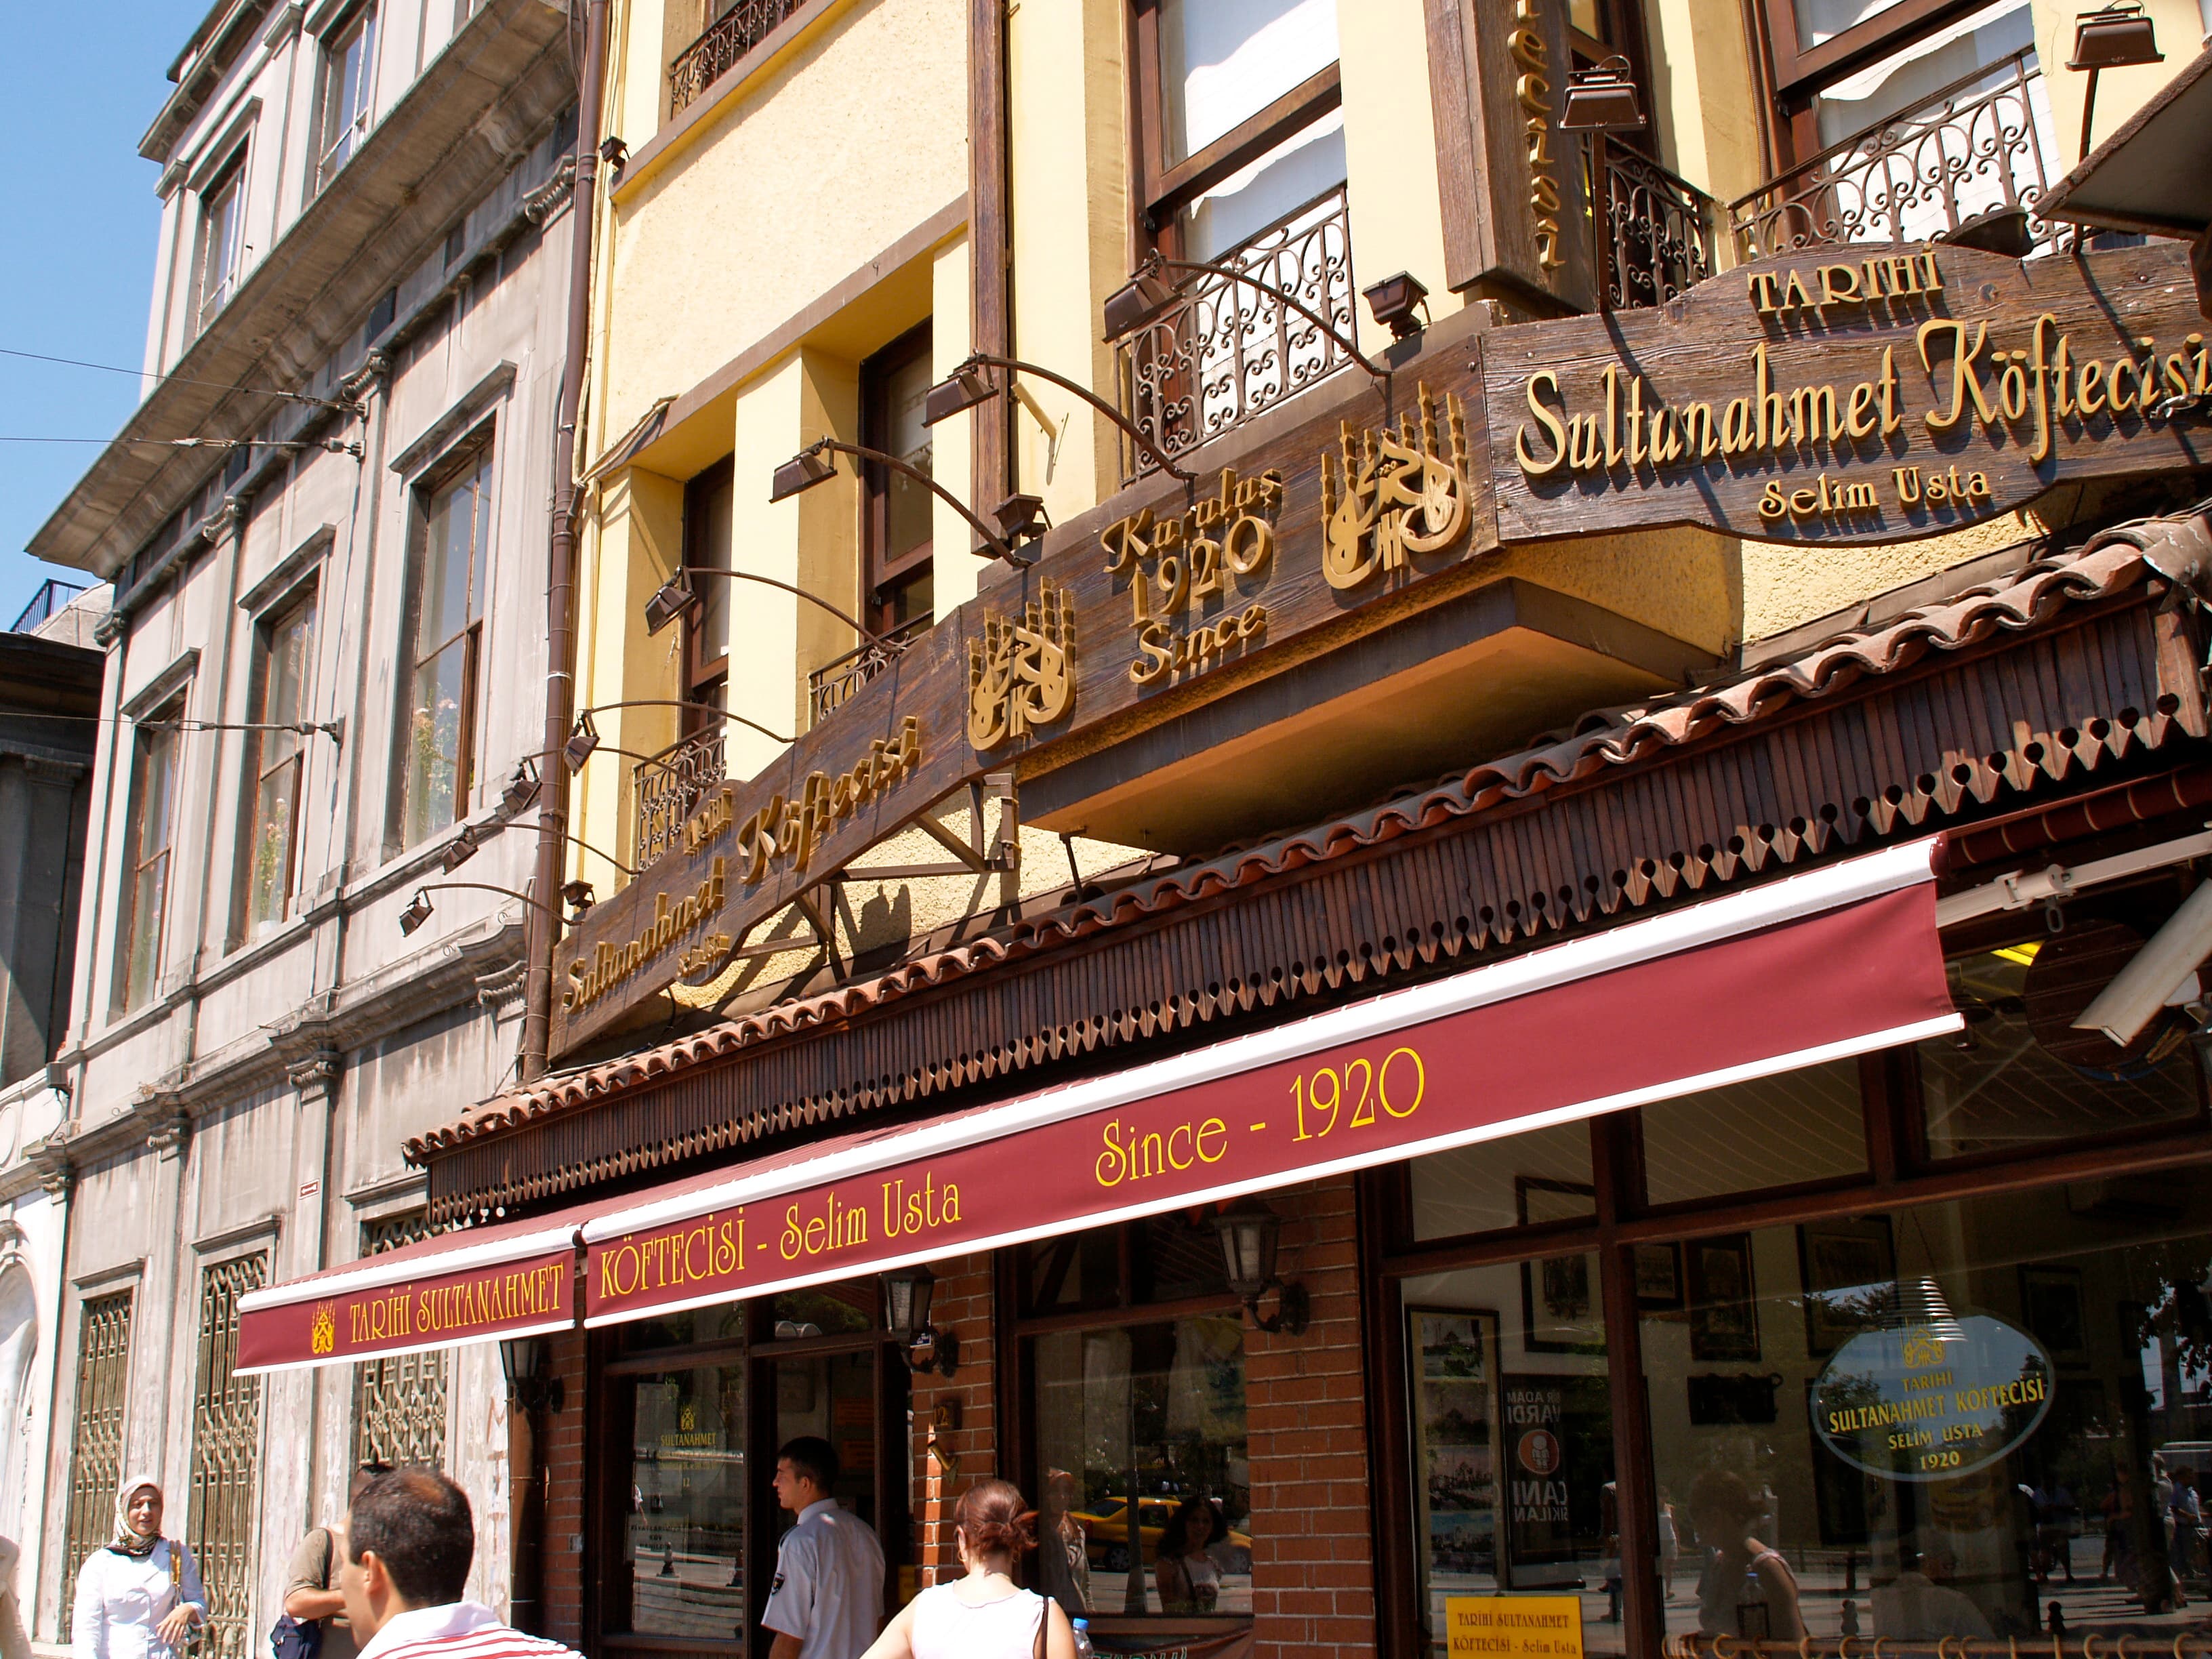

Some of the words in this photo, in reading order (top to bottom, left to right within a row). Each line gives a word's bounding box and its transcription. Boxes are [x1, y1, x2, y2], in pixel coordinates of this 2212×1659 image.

[1515, 342, 1902, 476] Sultanahmet
[1100, 468, 1282, 573] Kuruluş
[1758, 472, 1880, 518] Selim
[1891, 465, 1991, 503] Usta
[1127, 515, 1274, 628] 1920
[1129, 605, 1268, 684] Since
[737, 716, 921, 884] Köftecisi
[1095, 1118, 1227, 1187] Since
[1289, 1047, 1425, 1142] 1920
[598, 1207, 745, 1298] KÖFTECİSİ
[779, 1191, 868, 1261] Selim
[882, 1170, 962, 1238] Usta
[350, 1285, 412, 1343] TARİHİ
[416, 1261, 564, 1332] SULTANAHMET
[661, 1432, 716, 1447] SULTANAHMET
[1829, 1395, 1946, 1435] SULTANAHMET
[1956, 1371, 2045, 1413] KÖFTECİSİ
[1888, 1429, 1933, 1450] SELİM
[1942, 1422, 1984, 1442] USTA
[1919, 1450, 1961, 1470] 1920
[1452, 1635, 1511, 1652] KÖFTECİSİ
[1521, 1639, 1551, 1654] Selim
[1553, 1640, 1577, 1655] Usta
[1496, 1614, 1569, 1629] SULTANAHMET
